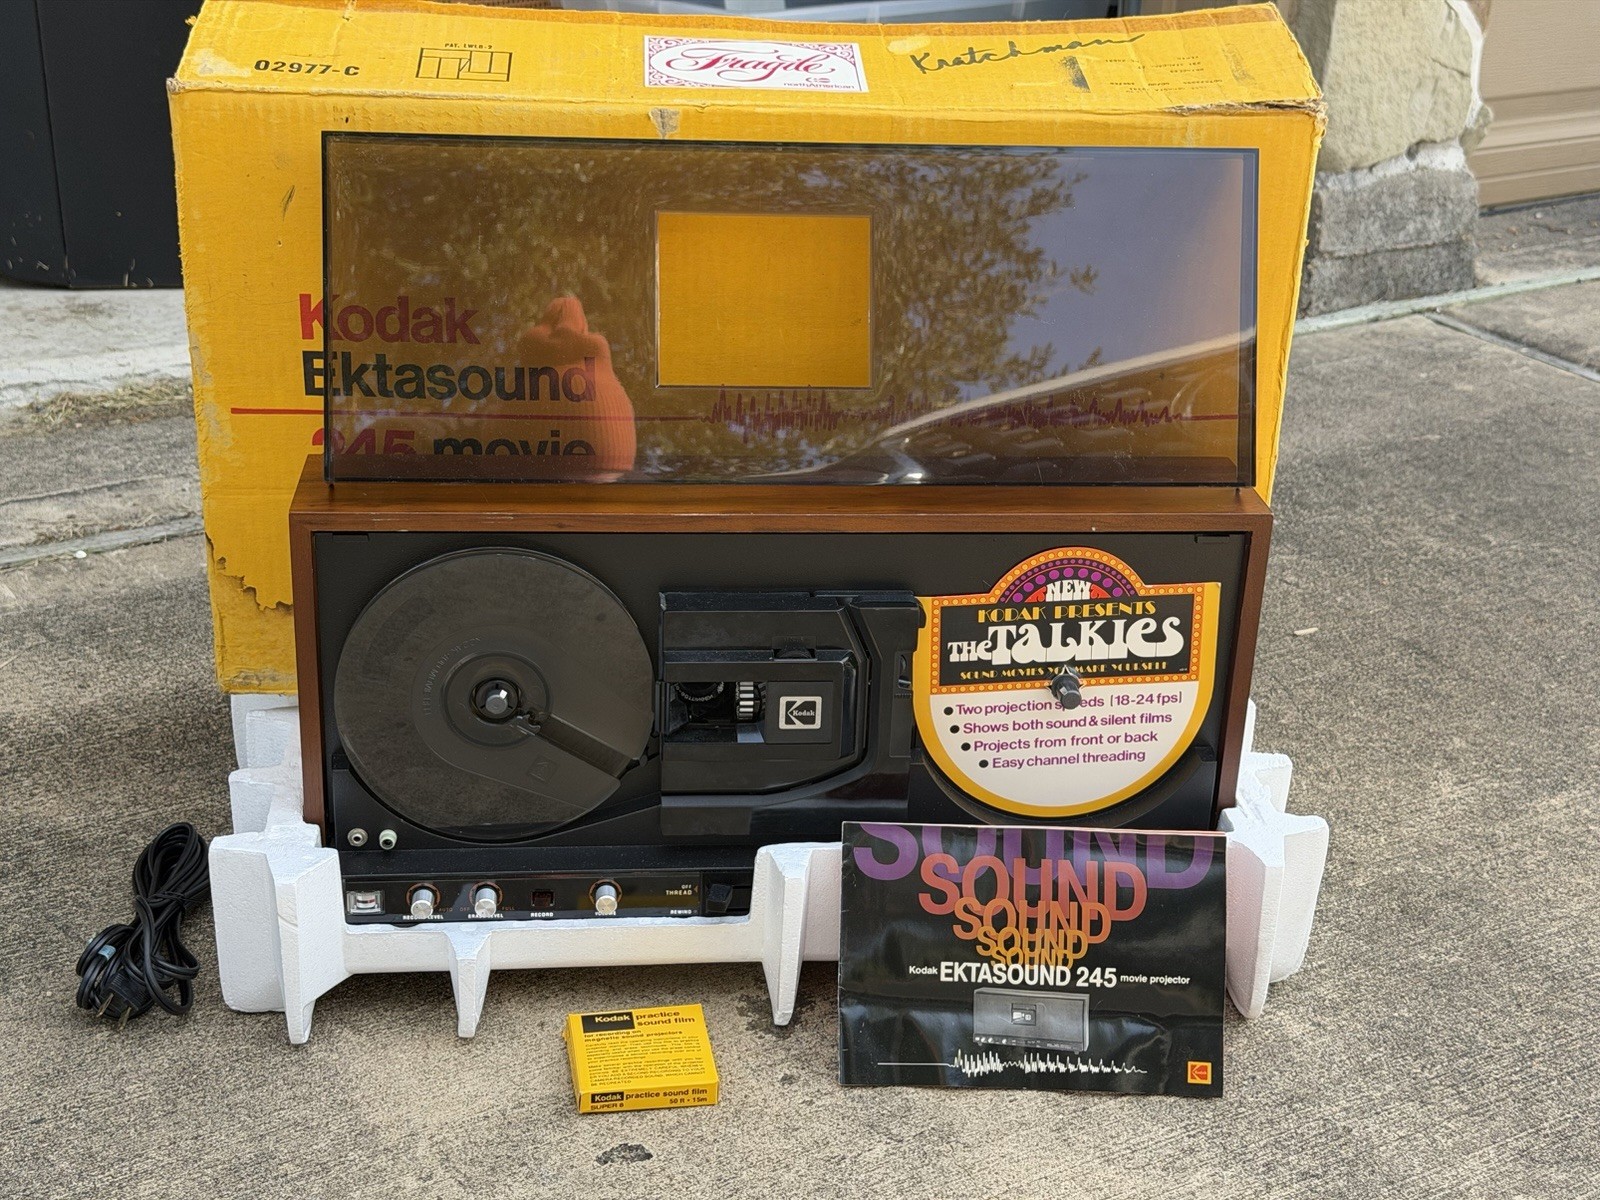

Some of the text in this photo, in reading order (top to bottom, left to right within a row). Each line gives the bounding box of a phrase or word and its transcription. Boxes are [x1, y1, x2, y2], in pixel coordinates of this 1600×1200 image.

[254, 58, 360, 78] 02977-C
[665, 48, 836, 82] Fragile
[298, 293, 481, 346] Kodak
[301, 350, 596, 402] Ektasound
[1045, 579, 1092, 602] NEW
[977, 600, 1157, 623] KODAK PRESENTS
[960, 670, 998, 680] SOUND
[1001, 668, 1045, 678] MOVIES
[956, 704, 982, 715] Two
[984, 701, 1051, 716] projection
[1054, 696, 1104, 711] seds
[963, 712, 1172, 734] Shows both sound & silent films
[973, 730, 1158, 753] Projects from front or back
[992, 750, 1146, 770] Easy channel threading
[854, 821, 1215, 889] SOUND
[918, 852, 1148, 922] SOUND
[952, 896, 1112, 944] SOUND
[976, 926, 1088, 960] SOUND
[908, 962, 1190, 988] Kodak EKTASOUND 245 movie projector
[595, 1014, 630, 1022] Kodak
[636, 1010, 680, 1020] practice
[637, 1016, 696, 1026] sound film
[590, 1103, 618, 1111] SUPER
[594, 1094, 622, 1102] Kodak
[626, 1091, 660, 1100] practice
